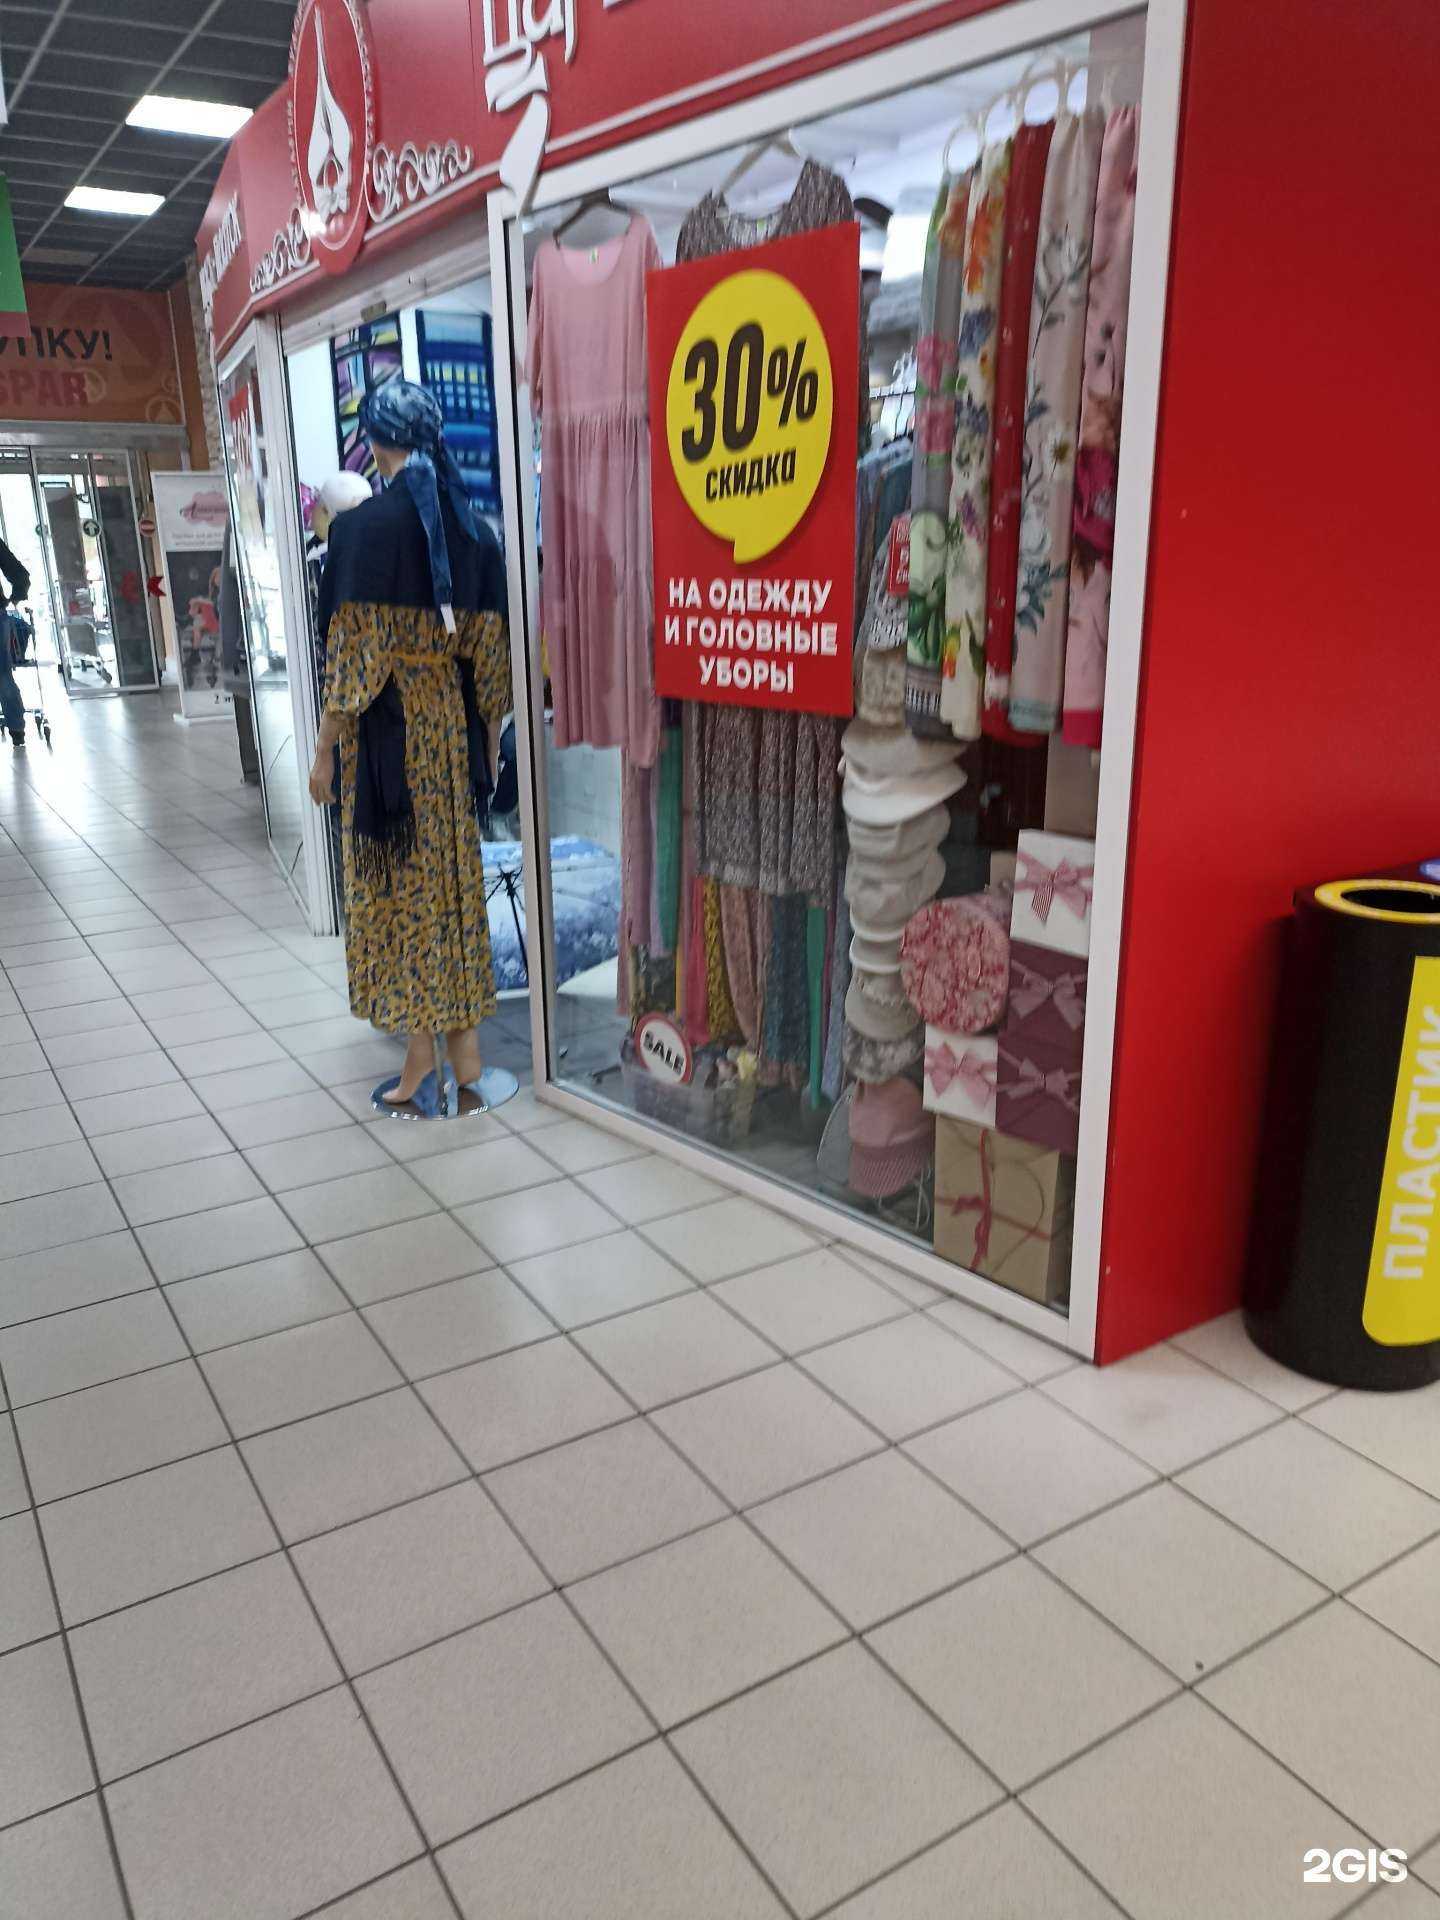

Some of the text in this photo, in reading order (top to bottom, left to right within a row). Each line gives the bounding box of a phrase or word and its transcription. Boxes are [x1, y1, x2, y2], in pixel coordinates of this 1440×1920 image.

[681, 319, 819, 465] 30%
[705, 448, 797, 503] скидка
[669, 577, 832, 618] НА ОДЕЖДУ
[664, 615, 838, 656] И ГОЛОВНЫЕ
[699, 655, 794, 693] УБОРЫ
[643, 1030, 684, 1075] SALE
